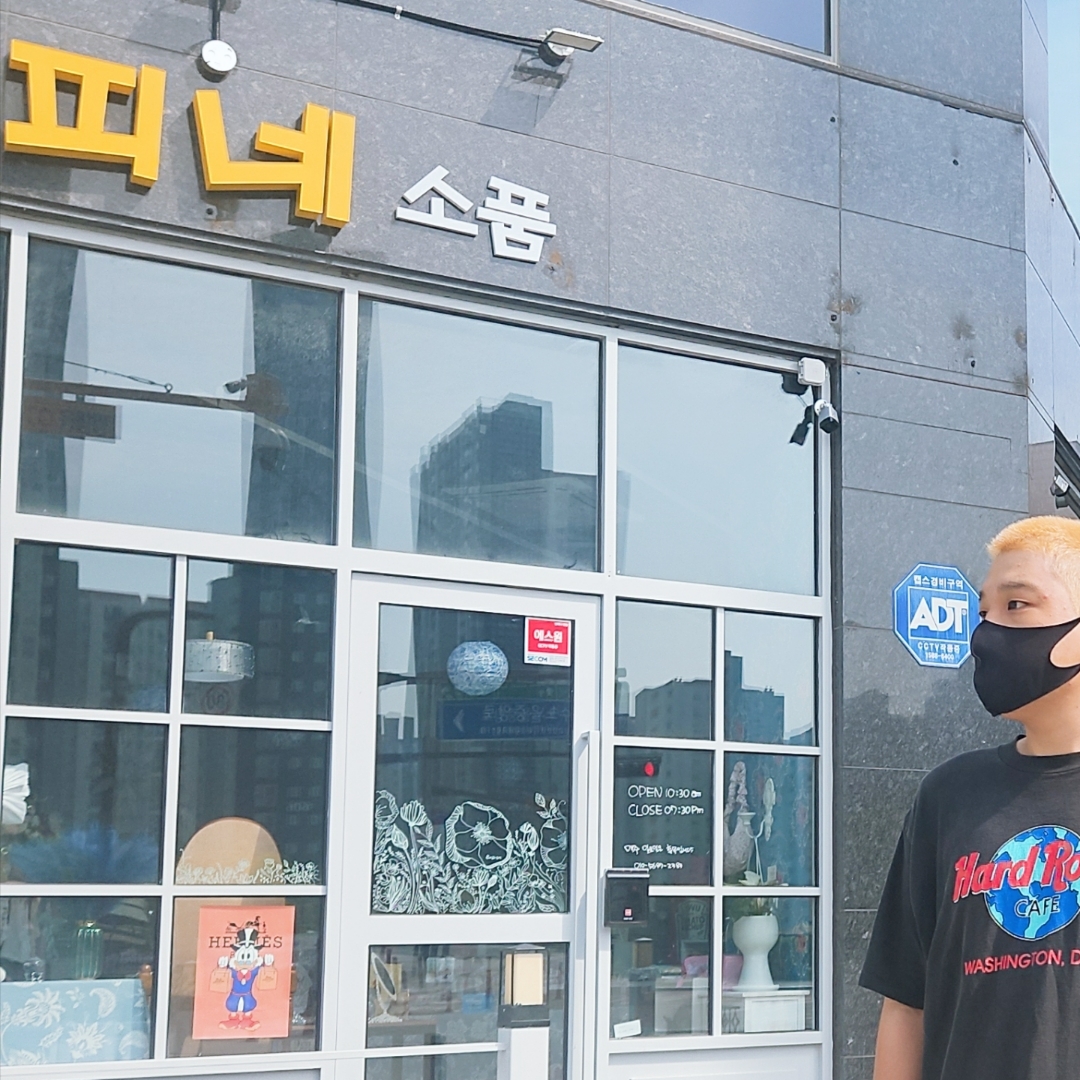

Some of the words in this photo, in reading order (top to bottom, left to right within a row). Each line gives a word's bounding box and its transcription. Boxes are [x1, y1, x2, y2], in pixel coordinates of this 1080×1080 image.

[395, 164, 557, 263] 소품
[910, 596, 968, 634] ADT
[533, 629, 563, 643] 에스원
[628, 785, 662, 798] OPEN
[628, 804, 662, 816] CLOSE
[952, 845, 1040, 903] Hard
[1015, 895, 1060, 917] CAFE
